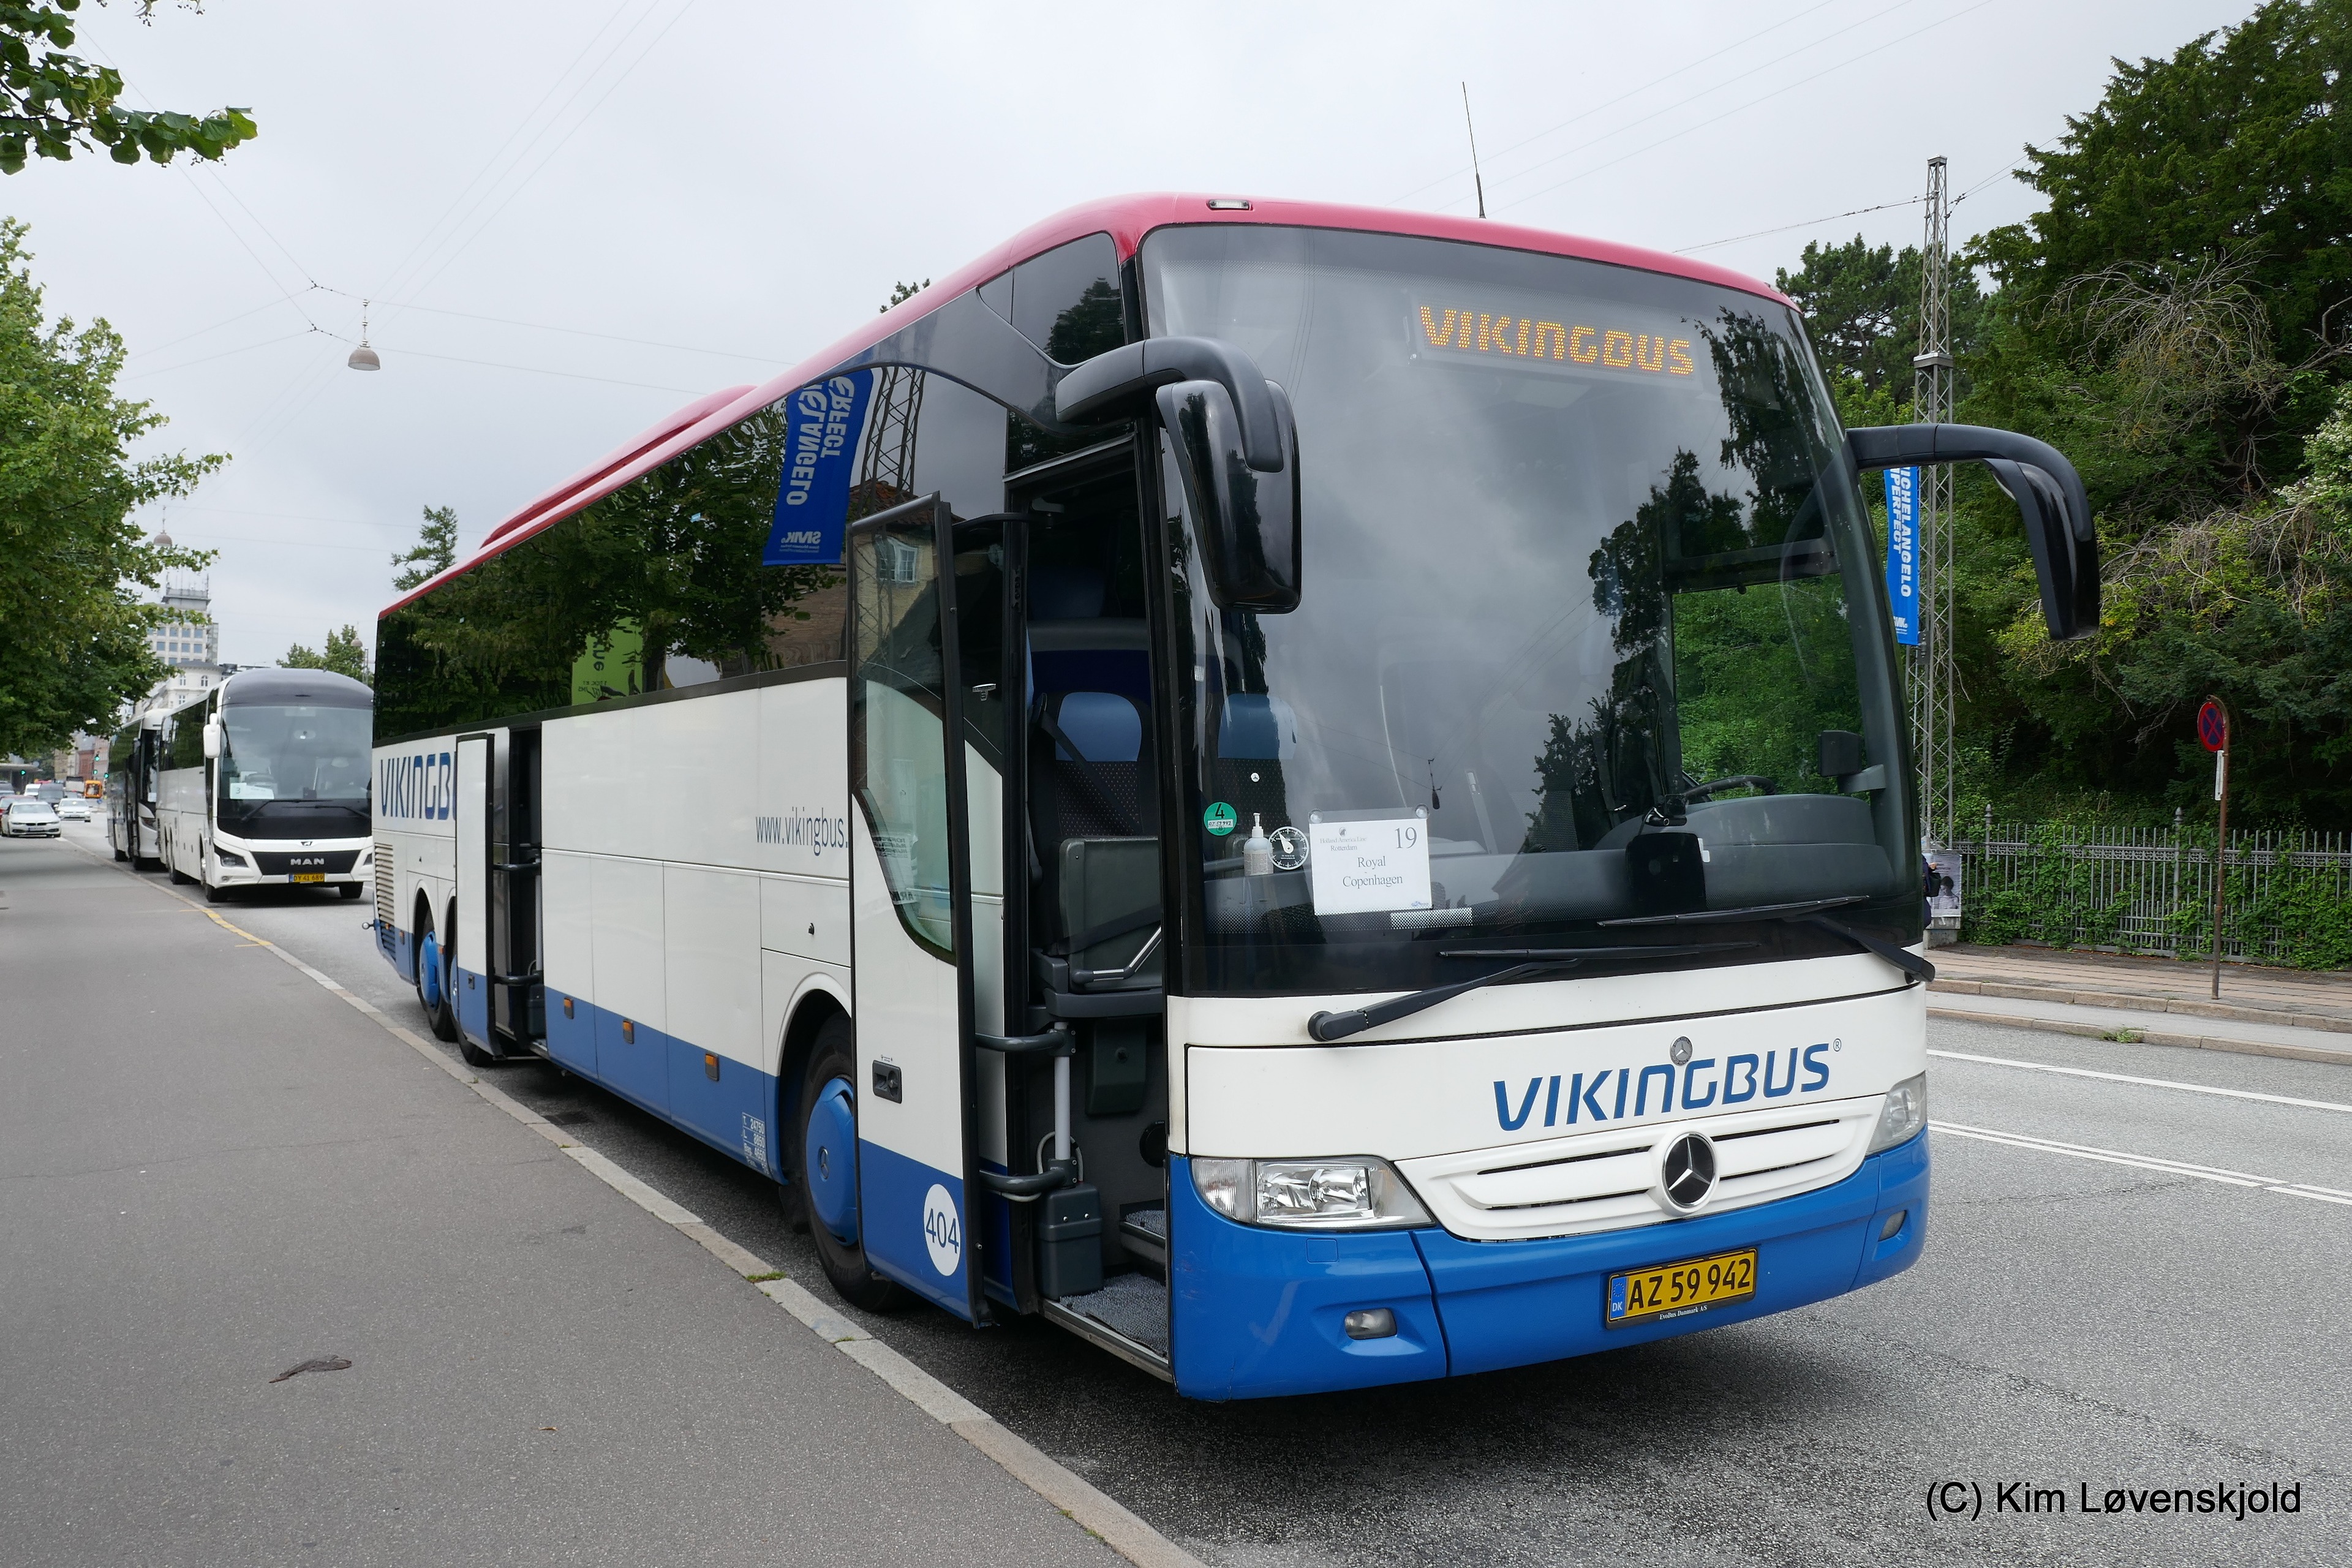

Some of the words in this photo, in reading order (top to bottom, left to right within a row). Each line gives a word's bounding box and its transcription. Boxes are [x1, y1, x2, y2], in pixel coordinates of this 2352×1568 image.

[1420, 306, 1694, 375] VIKINGBUS
[1899, 466, 1911, 597] ICHELANGELO
[380, 749, 456, 821] VIKINGB
[1215, 803, 1225, 819] 4
[755, 807, 848, 857] www.vikingbus.
[1395, 827, 1417, 849] 19
[1358, 856, 1386, 869] Royal
[1343, 875, 1403, 889] Copenhagen
[925, 1207, 959, 1254] 404
[1628, 1275, 1663, 1311] AZ
[1670, 1268, 1701, 1303] 59
[1707, 1257, 1751, 1295] 942
[1612, 1302, 1623, 1312] DK
[1659, 1311, 1677, 1321] EvoBus
[1677, 1306, 1699, 1317] Danmark
